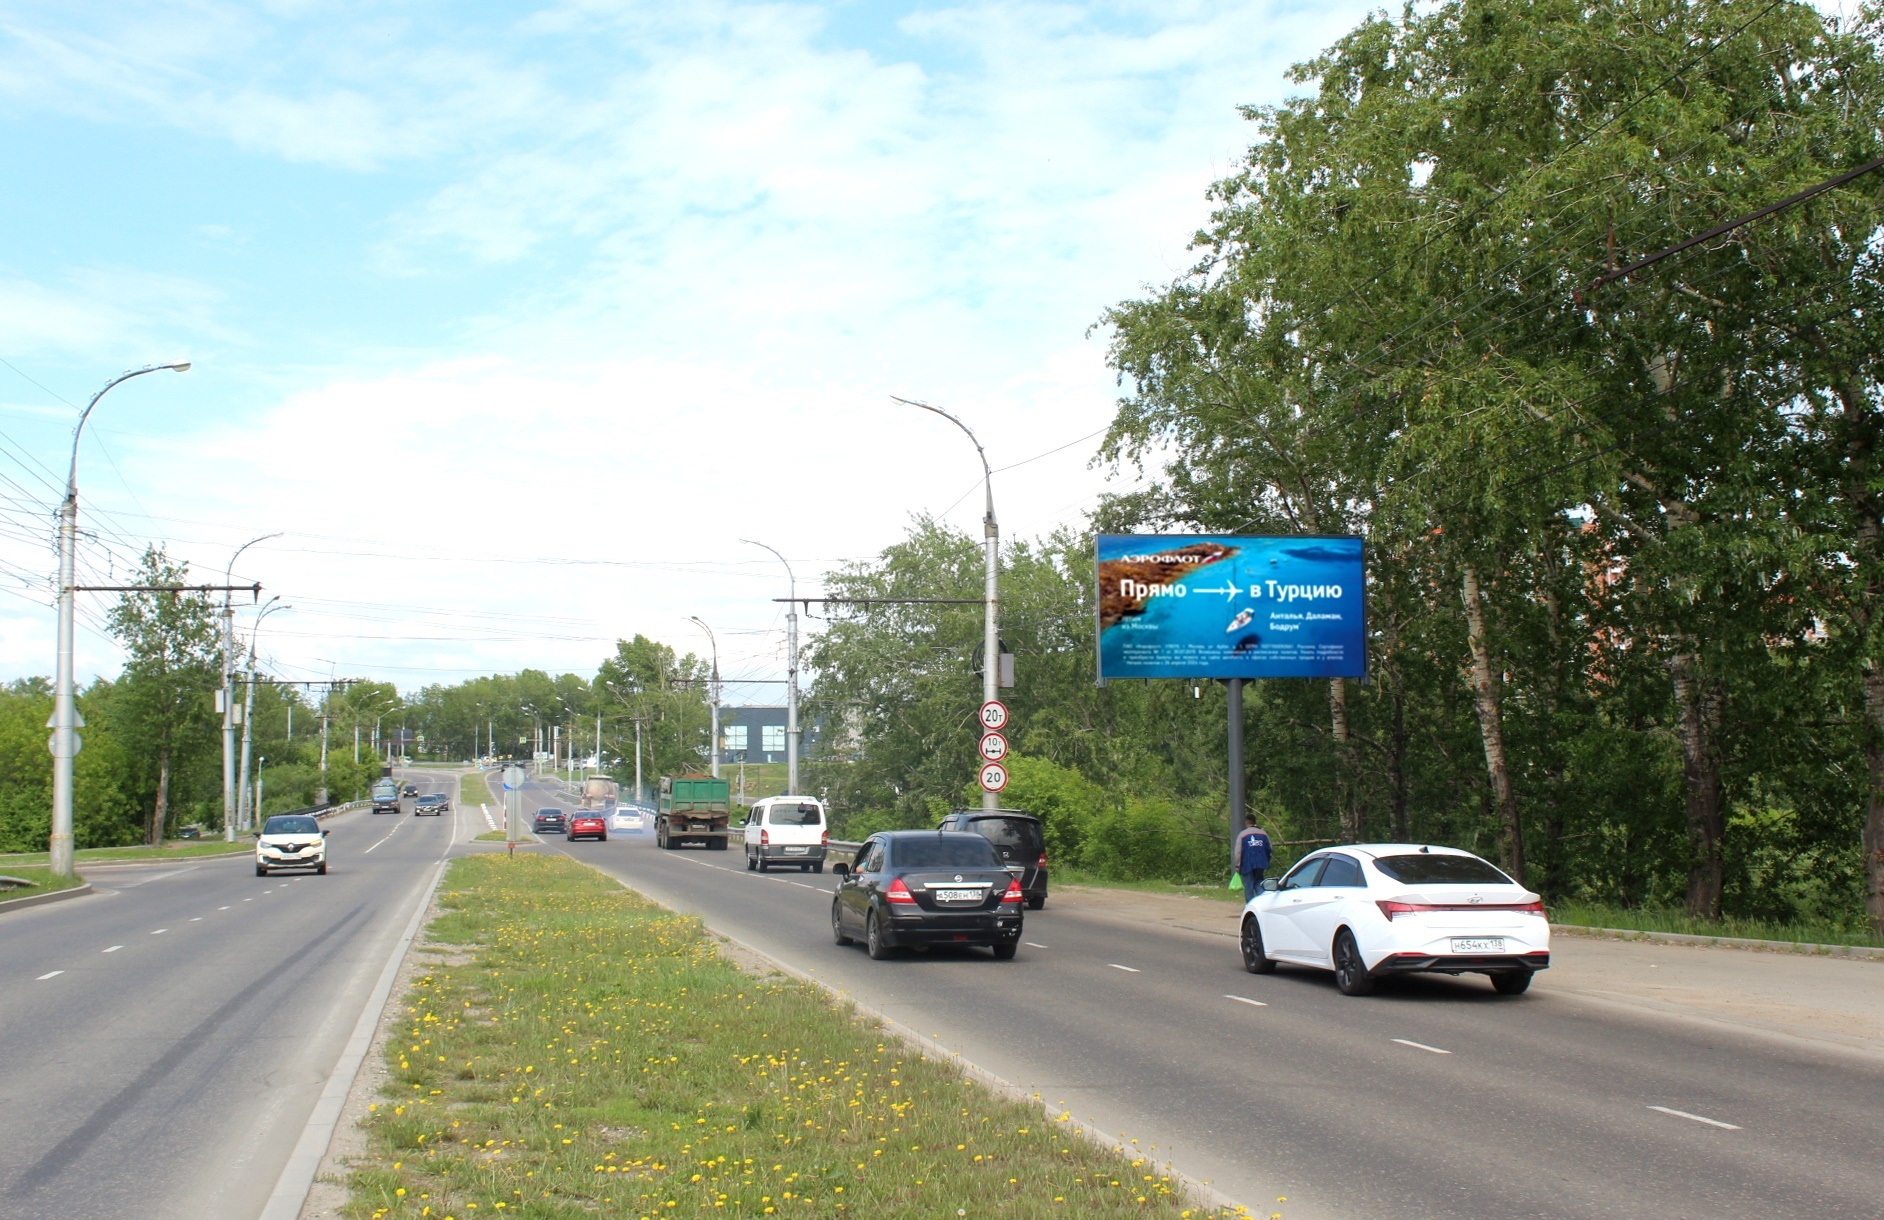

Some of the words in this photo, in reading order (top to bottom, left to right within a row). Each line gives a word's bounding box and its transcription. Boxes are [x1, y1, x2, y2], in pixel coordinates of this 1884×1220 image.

[1120, 554, 1201, 564] АЭРОФЛОТ
[1120, 580, 1187, 602] Прямо
[1250, 584, 1261, 598] в
[1265, 580, 1342, 602] Турцию
[986, 772, 1001, 783] 20
